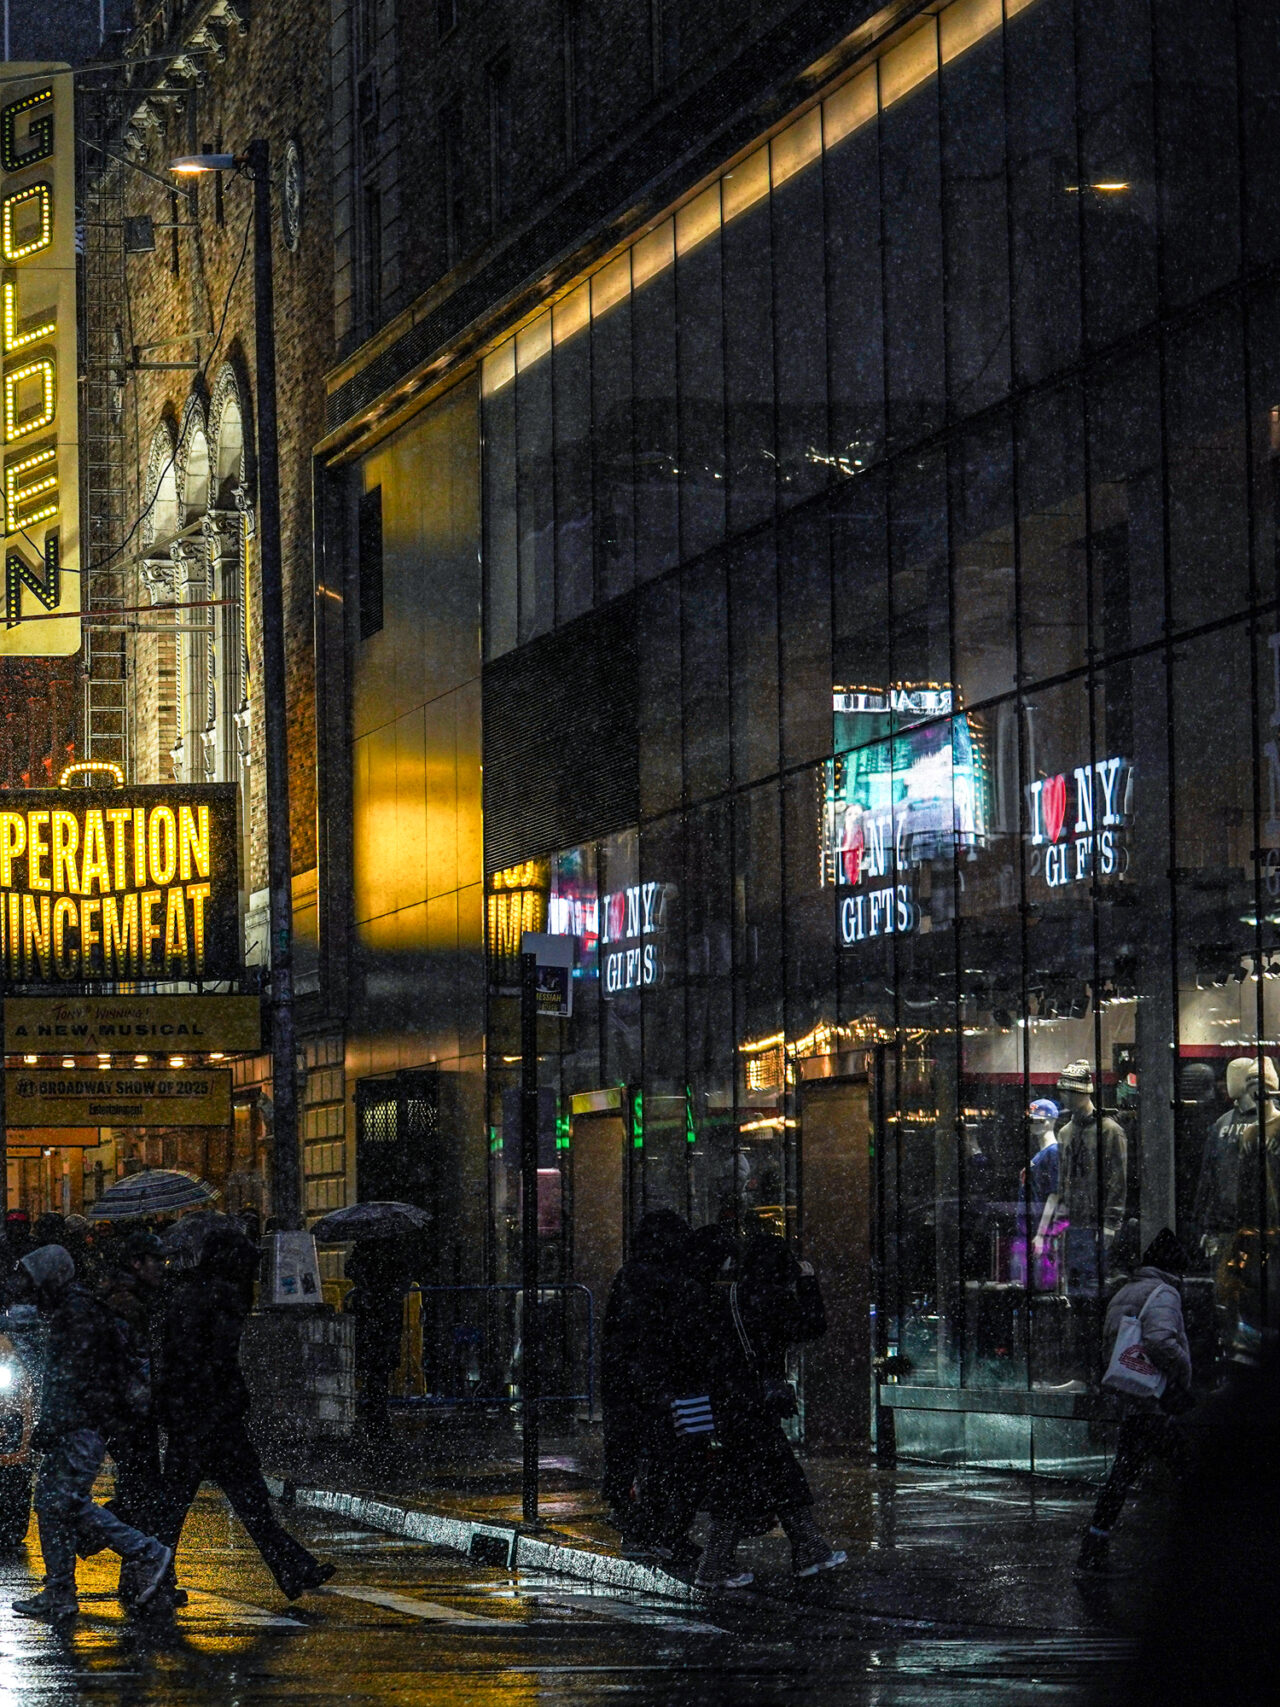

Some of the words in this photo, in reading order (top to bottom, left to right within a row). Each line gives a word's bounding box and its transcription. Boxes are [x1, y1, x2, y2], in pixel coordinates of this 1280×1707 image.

[0, 87, 60, 630] GOLDEN
[842, 884, 910, 943] GIFTS
[607, 944, 657, 993] GIFTS
[15, 1025, 28, 1035] A
[38, 1025, 88, 1035] NEW
[99, 1024, 204, 1035] MUSICAL
[39, 1081, 114, 1095] BROADWAY
[116, 1081, 155, 1095] SHOW
[158, 1081, 173, 1094] OF
